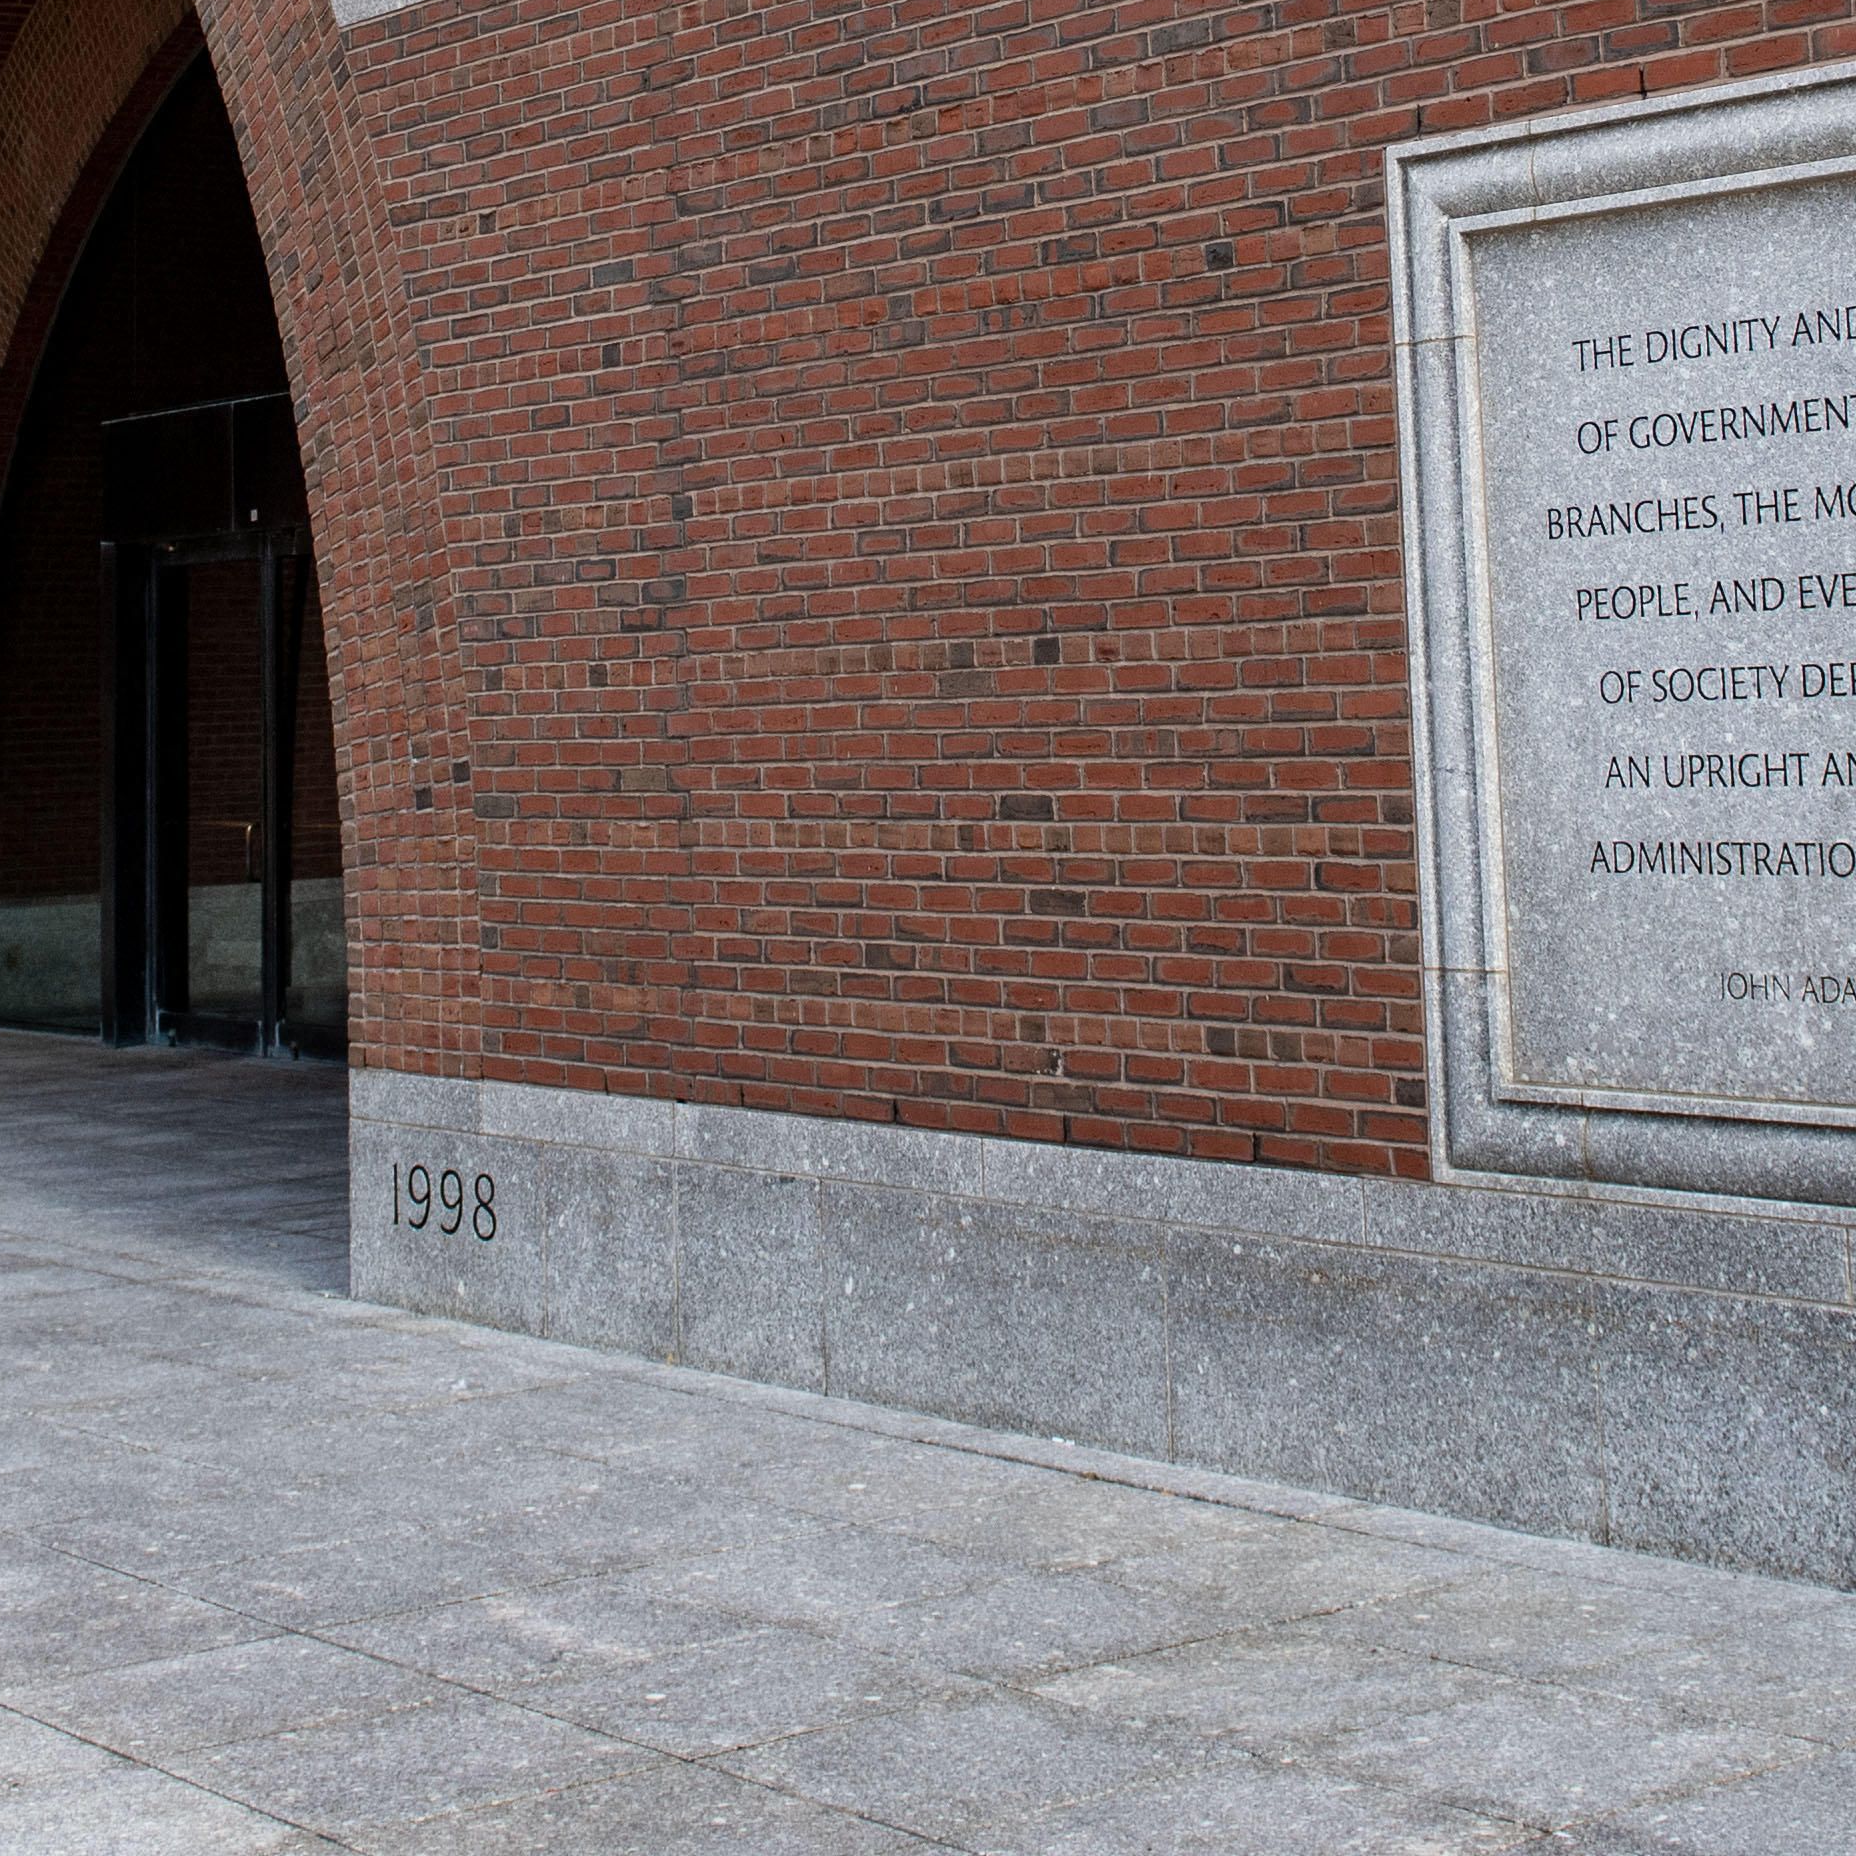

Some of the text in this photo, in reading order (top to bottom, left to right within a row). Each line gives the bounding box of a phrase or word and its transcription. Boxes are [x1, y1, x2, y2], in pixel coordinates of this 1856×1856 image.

[1572, 335, 1634, 373] THE
[1646, 315, 1781, 365] DIGNITY
[1577, 420, 1620, 455] OF
[1547, 494, 1726, 541] BRANCHES,
[1733, 488, 1802, 526] THE
[1576, 582, 1700, 622] PEOPLE,
[1709, 576, 1785, 615] AND
[1599, 669, 1638, 705] OF
[1652, 664, 1790, 704] SOCIETY
[1604, 754, 1651, 790] AN
[1663, 752, 1810, 789] UPRIGHT
[1720, 971, 1791, 1003] JOHN
[393, 1163, 497, 1242] 1998
